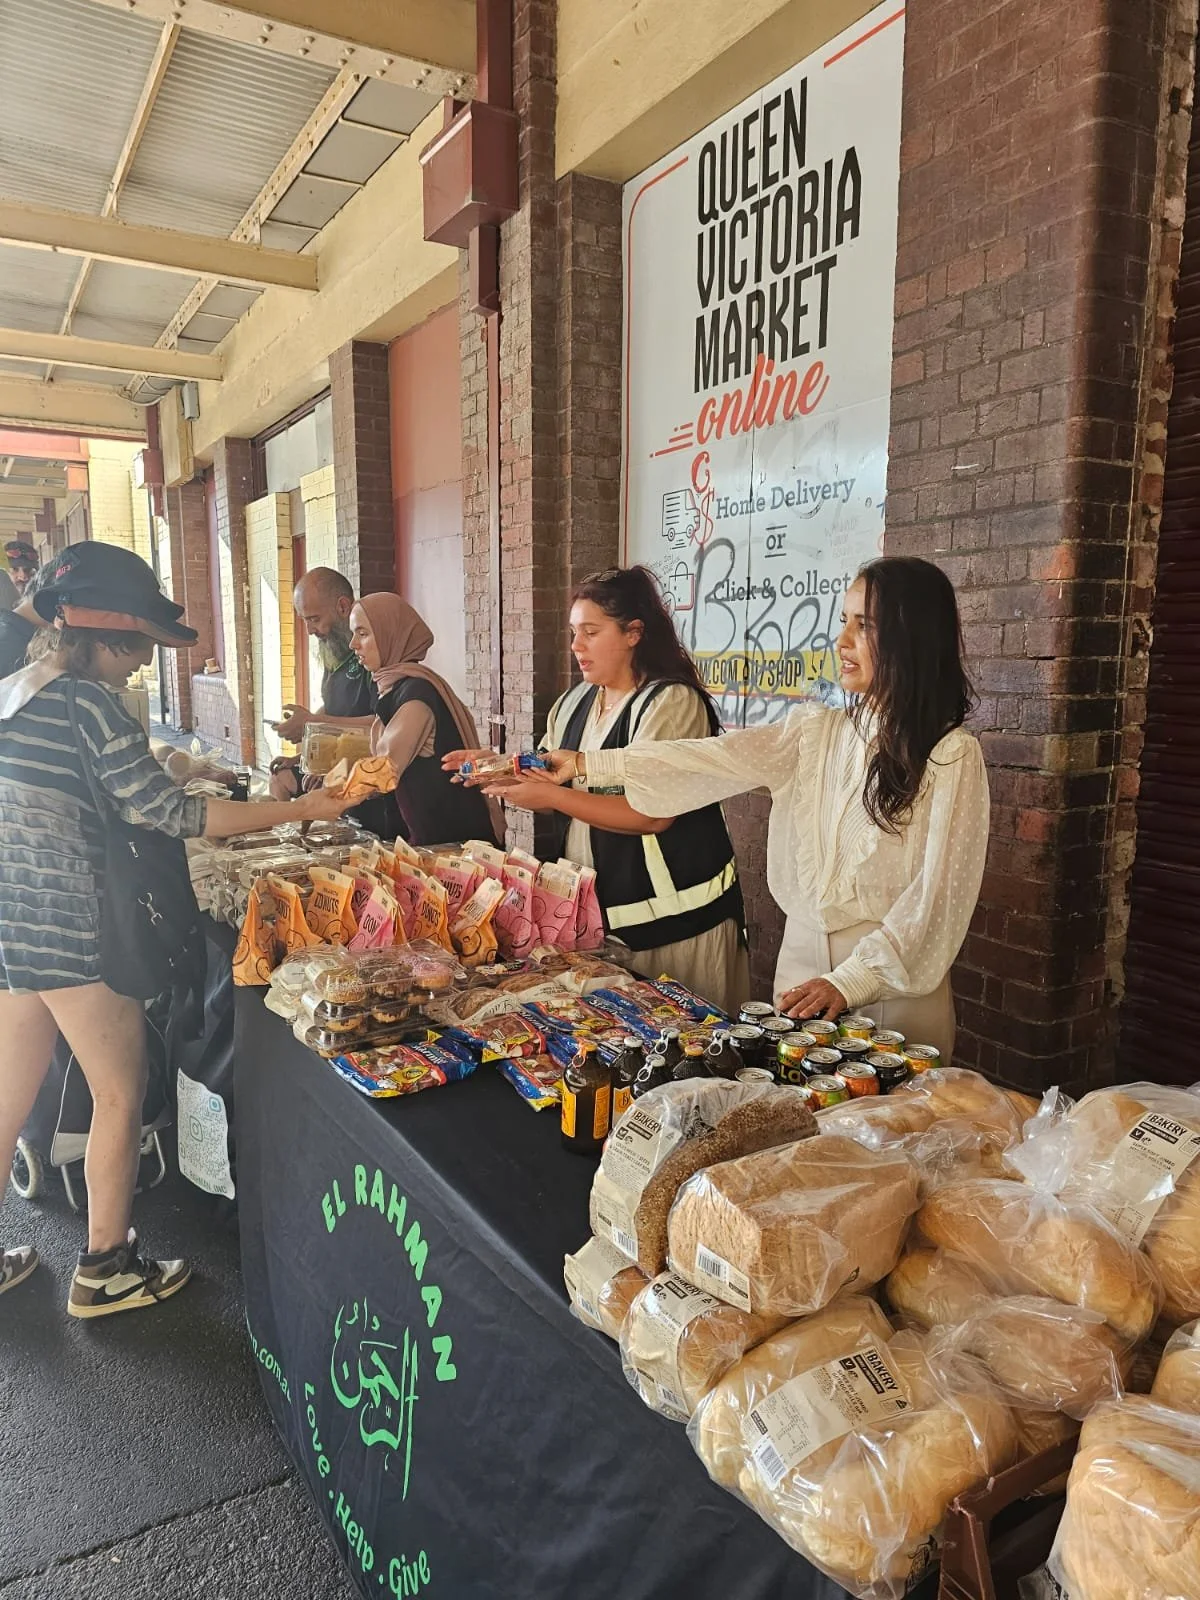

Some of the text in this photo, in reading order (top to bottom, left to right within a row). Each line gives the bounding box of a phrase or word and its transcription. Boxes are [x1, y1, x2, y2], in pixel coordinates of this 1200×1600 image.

[697, 77, 808, 225] QUEEN
[697, 145, 862, 309] VICTORIA
[694, 254, 837, 394] MARKET
[696, 353, 830, 446] online
[716, 495, 766, 519] Home
[770, 477, 856, 510] Delivery
[766, 531, 786, 550] or
[713, 570, 851, 602] Click & Collect
[635, 1112, 663, 1134] BAKERY
[1149, 1114, 1188, 1138] BAKERY
[321, 1164, 457, 1382] EL RAHMAN
[866, 1350, 898, 1392] BAKERY
[303, 1383, 331, 1478] Love
